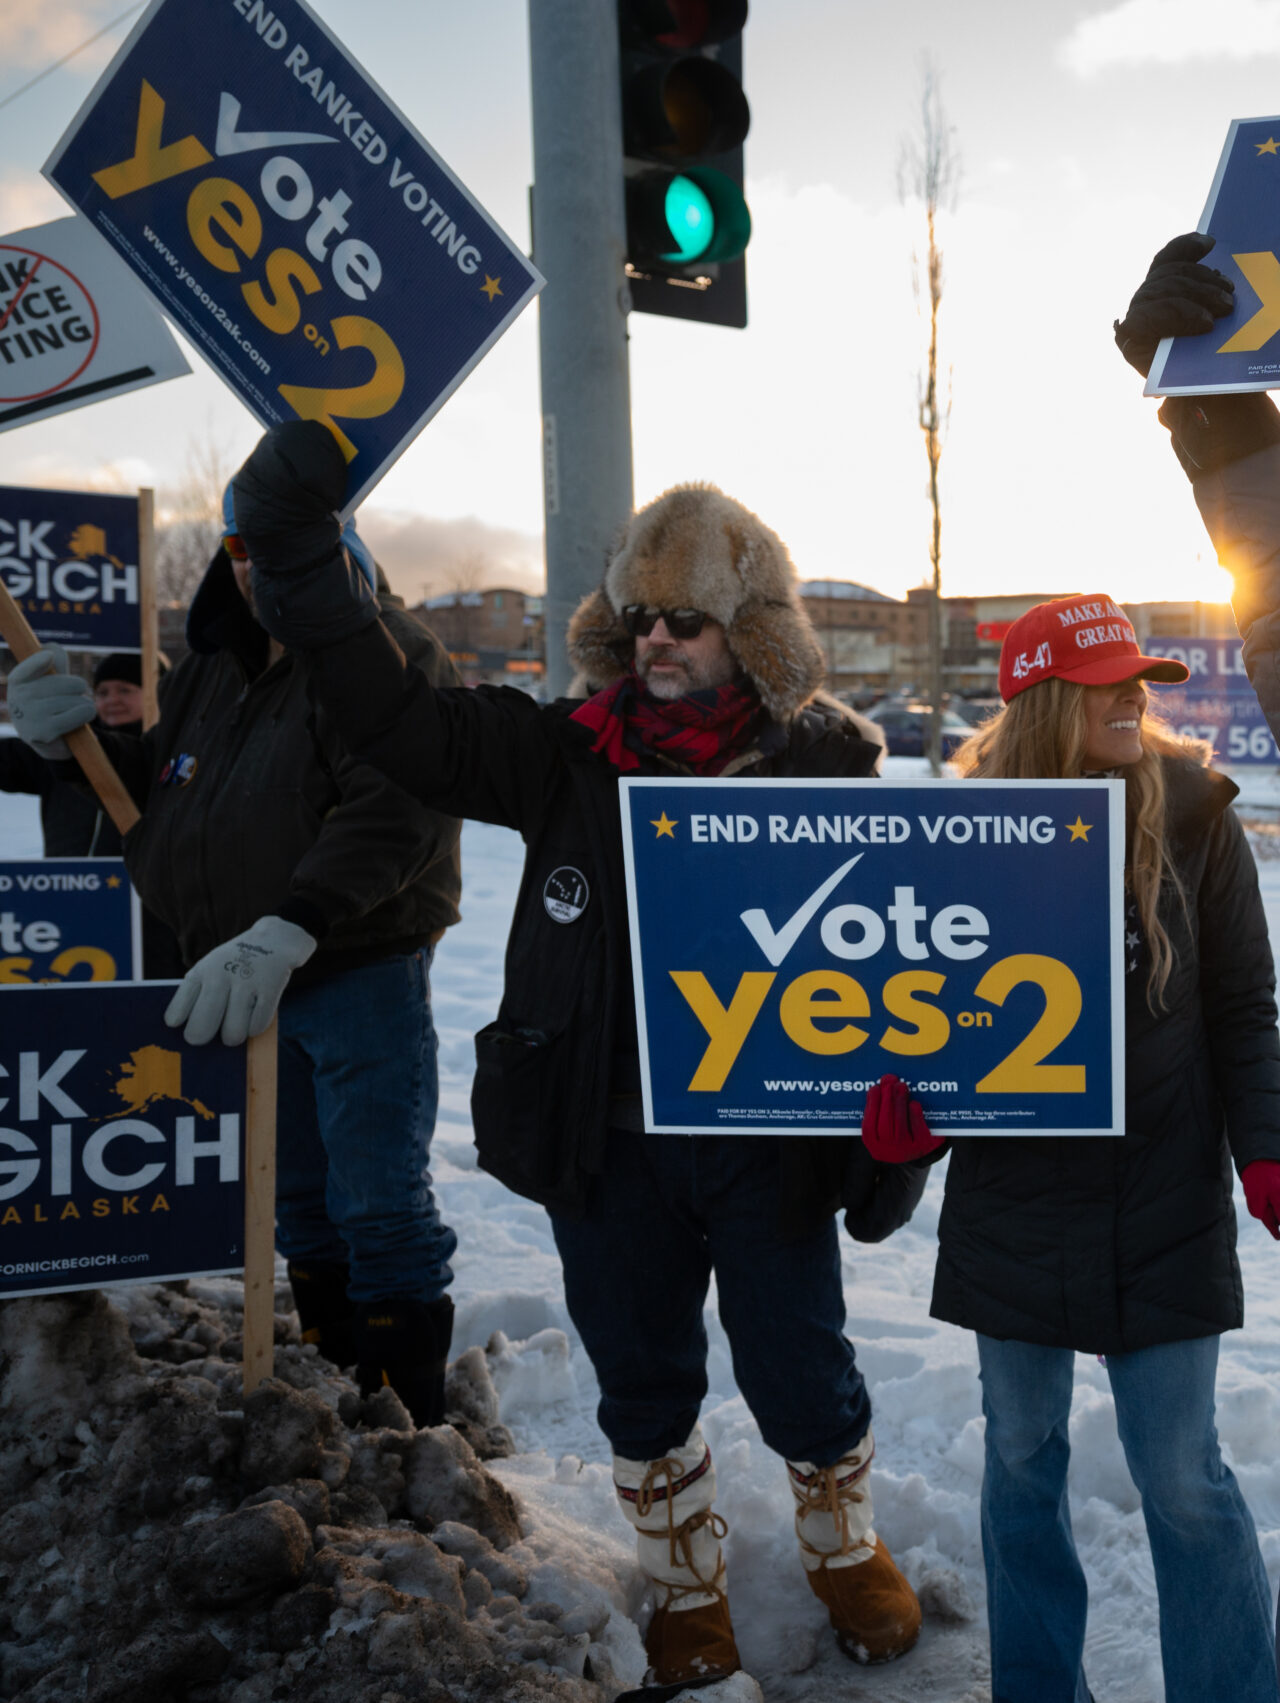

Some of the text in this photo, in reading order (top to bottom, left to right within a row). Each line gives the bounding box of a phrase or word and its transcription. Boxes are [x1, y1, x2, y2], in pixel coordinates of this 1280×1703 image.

[233, 0, 482, 275] END RANKED VOTING
[0, 285, 72, 328] ICE
[143, 224, 271, 375] www.yeson2ak.com
[303, 323, 330, 356] on
[277, 315, 406, 465] 2
[1056, 602, 1105, 628] MAKE
[1075, 623, 1122, 649] GREAT
[1012, 641, 1052, 679] 45-47
[690, 815, 1056, 844] END RANKED VOTING
[16, 873, 101, 892] VOTING
[957, 1011, 993, 1027] on
[974, 953, 1086, 1093] 2
[0, 1049, 88, 1121] K
[764, 1078, 959, 1095] www.yeson.com
[1, 1194, 170, 1225] ALASKA
